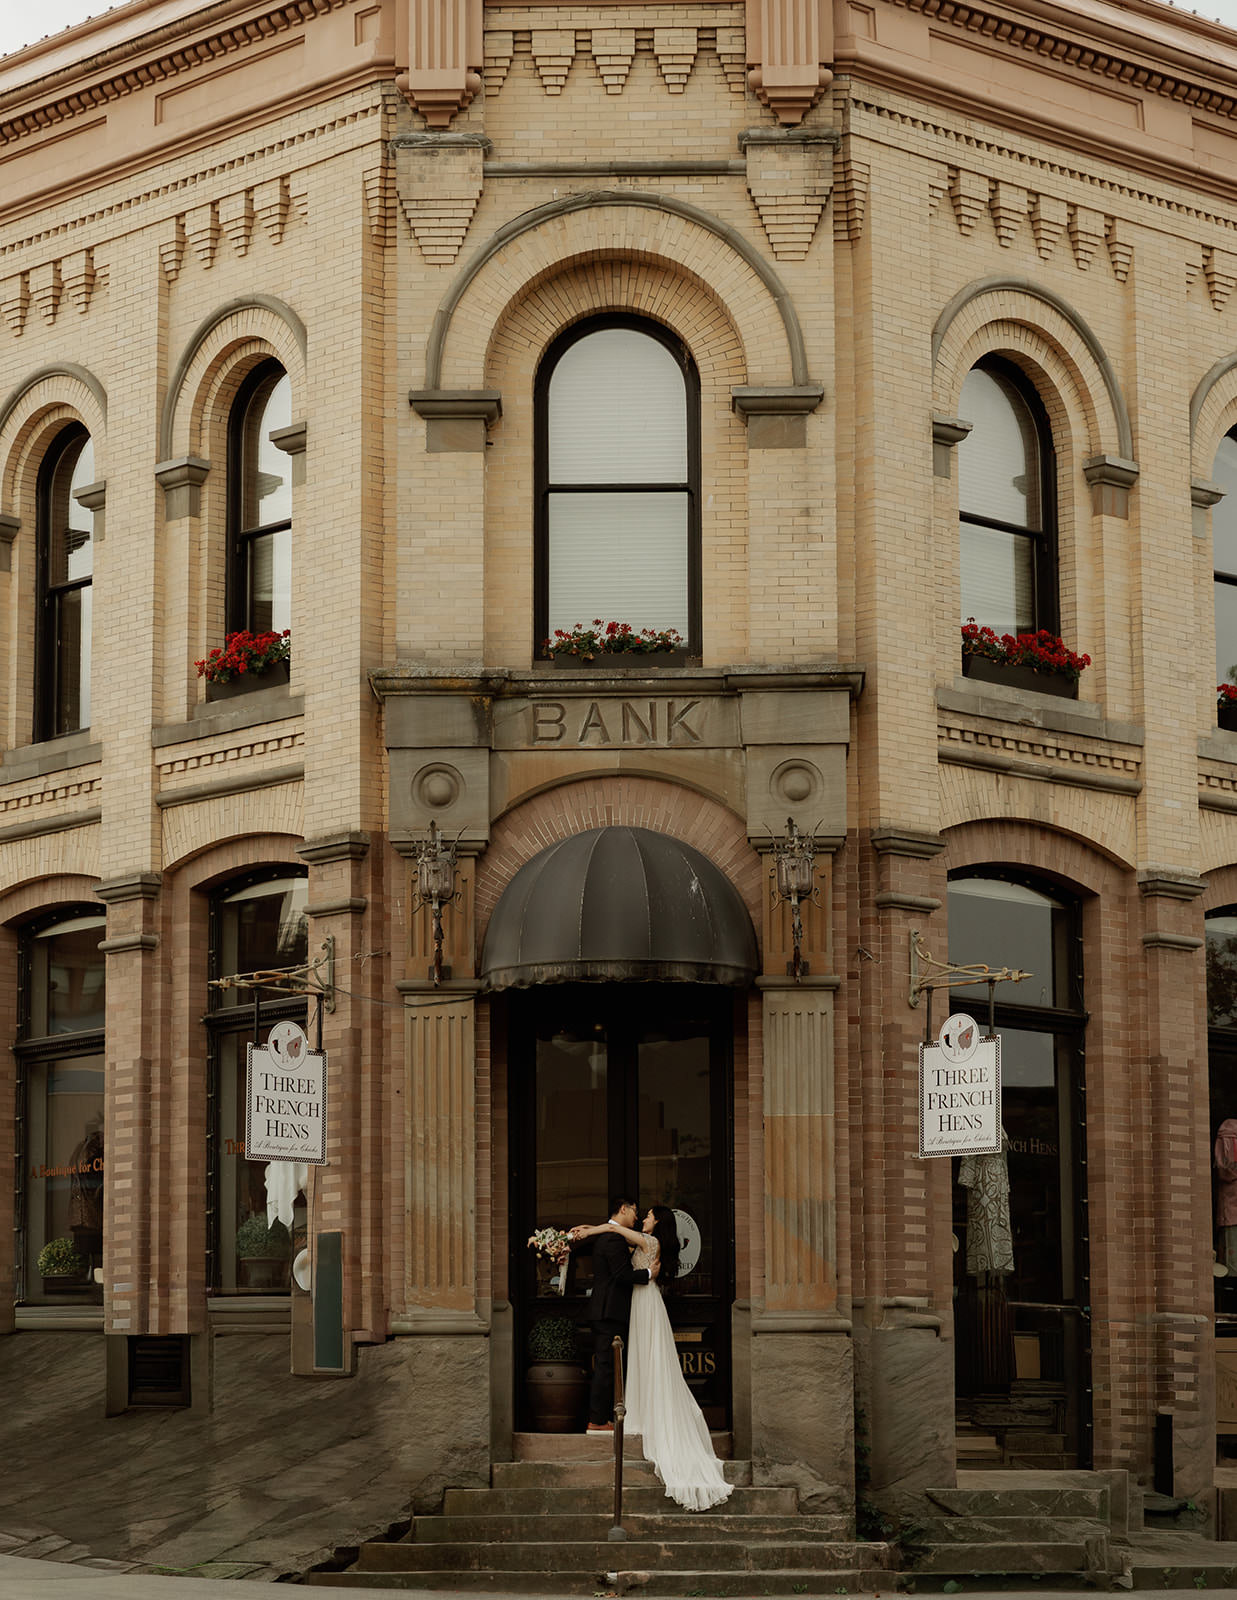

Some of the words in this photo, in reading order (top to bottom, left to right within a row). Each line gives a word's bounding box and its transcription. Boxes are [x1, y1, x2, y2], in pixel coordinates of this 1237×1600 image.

[532, 701, 701, 745] BANK
[260, 1072, 316, 1095] THREE
[932, 1067, 988, 1087] THREE
[255, 1095, 320, 1118] FRENCH
[927, 1090, 993, 1110] FRENCH
[266, 1119, 309, 1140] HENS
[938, 1114, 983, 1132] HENS
[225, 1138, 246, 1156] THR
[1008, 1139, 1027, 1153] NCH
[40, 1164, 77, 1179] Boutique
[79, 1160, 92, 1173] for
[678, 1262, 694, 1270] SED
